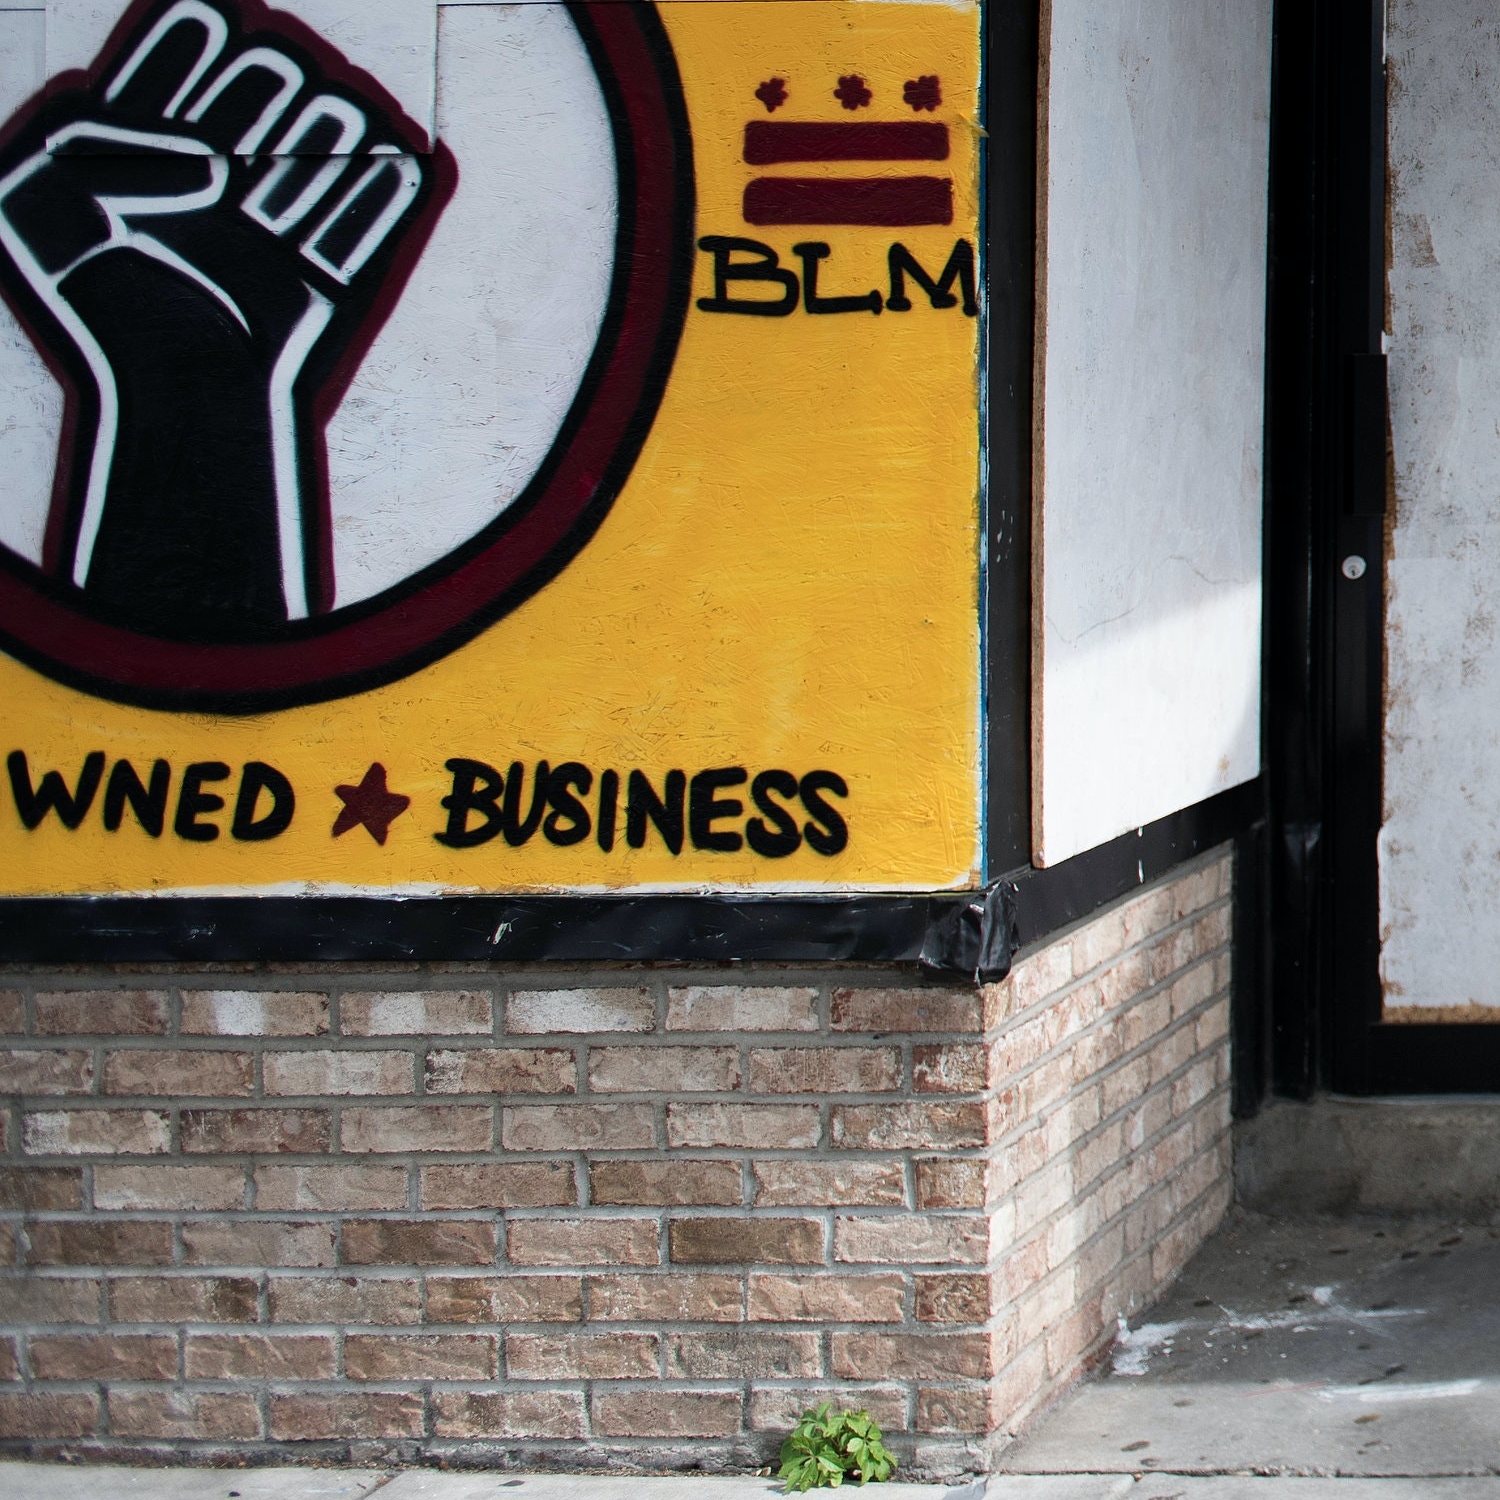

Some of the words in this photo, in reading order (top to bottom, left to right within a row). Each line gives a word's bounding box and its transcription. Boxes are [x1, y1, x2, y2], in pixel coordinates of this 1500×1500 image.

[697, 235, 979, 318] BLM
[7, 750, 294, 842] WNED
[435, 758, 849, 857] BUSINESS
